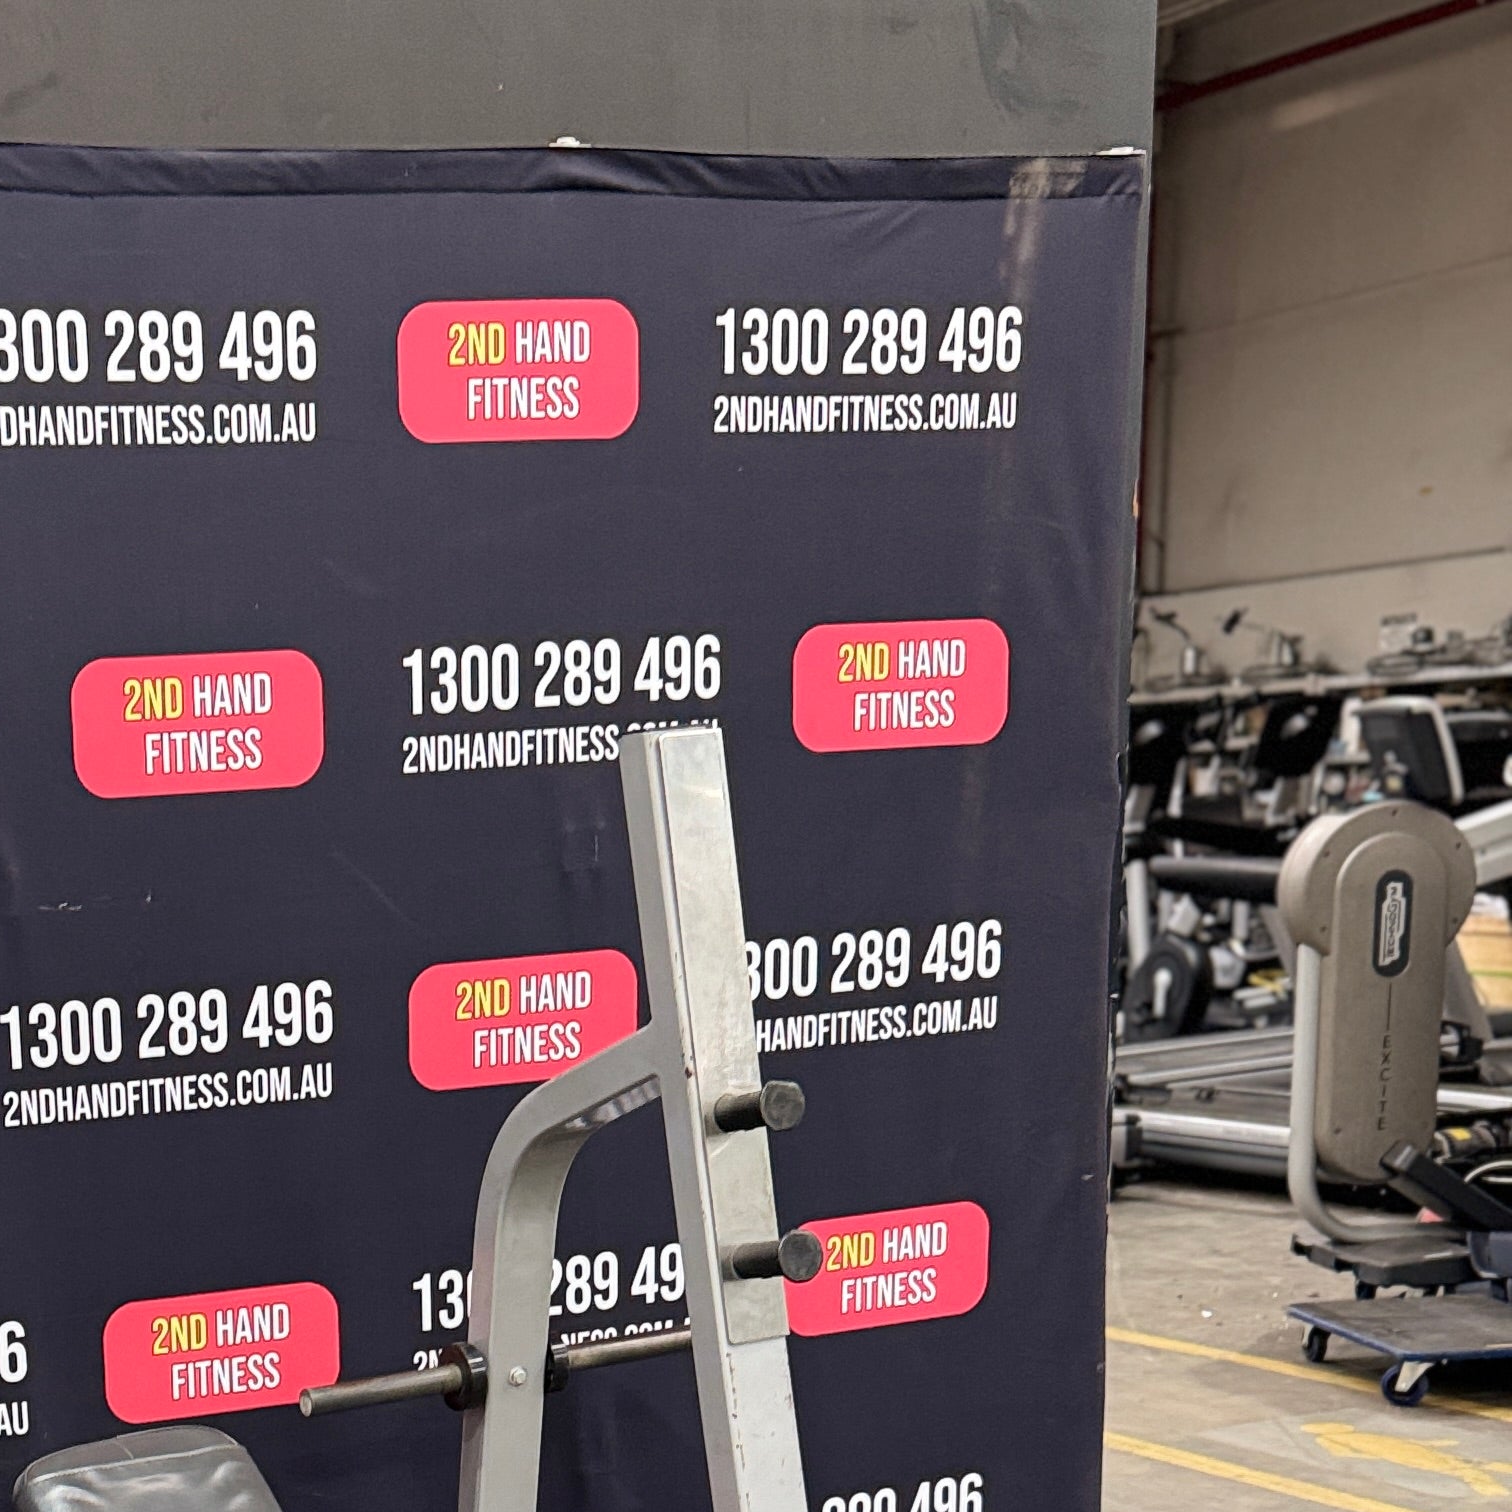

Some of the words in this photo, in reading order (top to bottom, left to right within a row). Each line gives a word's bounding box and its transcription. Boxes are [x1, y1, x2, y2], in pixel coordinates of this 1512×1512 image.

[105, 310, 203, 382] 289
[219, 310, 316, 381] 496
[449, 323, 504, 365] 2ND
[516, 321, 590, 363] HAND
[716, 308, 828, 375] 1300
[843, 308, 926, 374] 289
[939, 306, 1022, 373] 496
[469, 376, 579, 419] FITNESS
[714, 392, 1016, 432] 2NDHANDFITNESS.COM.AU
[403, 644, 519, 715] 1300
[535, 638, 620, 707] 289
[634, 634, 720, 701] 496
[839, 643, 889, 681] 2ND
[899, 640, 965, 678] HAND
[124, 678, 182, 720] 2ND
[194, 673, 271, 717] HAND
[855, 689, 954, 730] FITNESS
[146, 728, 261, 774] FITNESS
[403, 719, 719, 774] 2NDHANDFITNESS
[745, 936, 818, 1001] 300
[831, 928, 910, 993] 289
[922, 919, 1001, 982] 496
[457, 979, 510, 1019] 2ND
[521, 971, 591, 1013] HAND
[0, 998, 122, 1069] 1300
[137, 989, 227, 1058] 289
[243, 980, 333, 1048] 496
[475, 1022, 580, 1067] FITNESS
[756, 996, 998, 1053] HANDFITNESS.COM.AU
[3, 1063, 332, 1127] 2NDHANDFITNESS.COM.AU
[1377, 1034, 1392, 1132] EXCITE
[827, 1233, 874, 1271] 2ND
[883, 1222, 947, 1263] HAND
[630, 1243, 686, 1304] 49
[842, 1268, 936, 1313] FITNESS
[153, 1314, 206, 1354] 2ND
[217, 1304, 289, 1346] HAND
[172, 1352, 280, 1399] FITNESS
